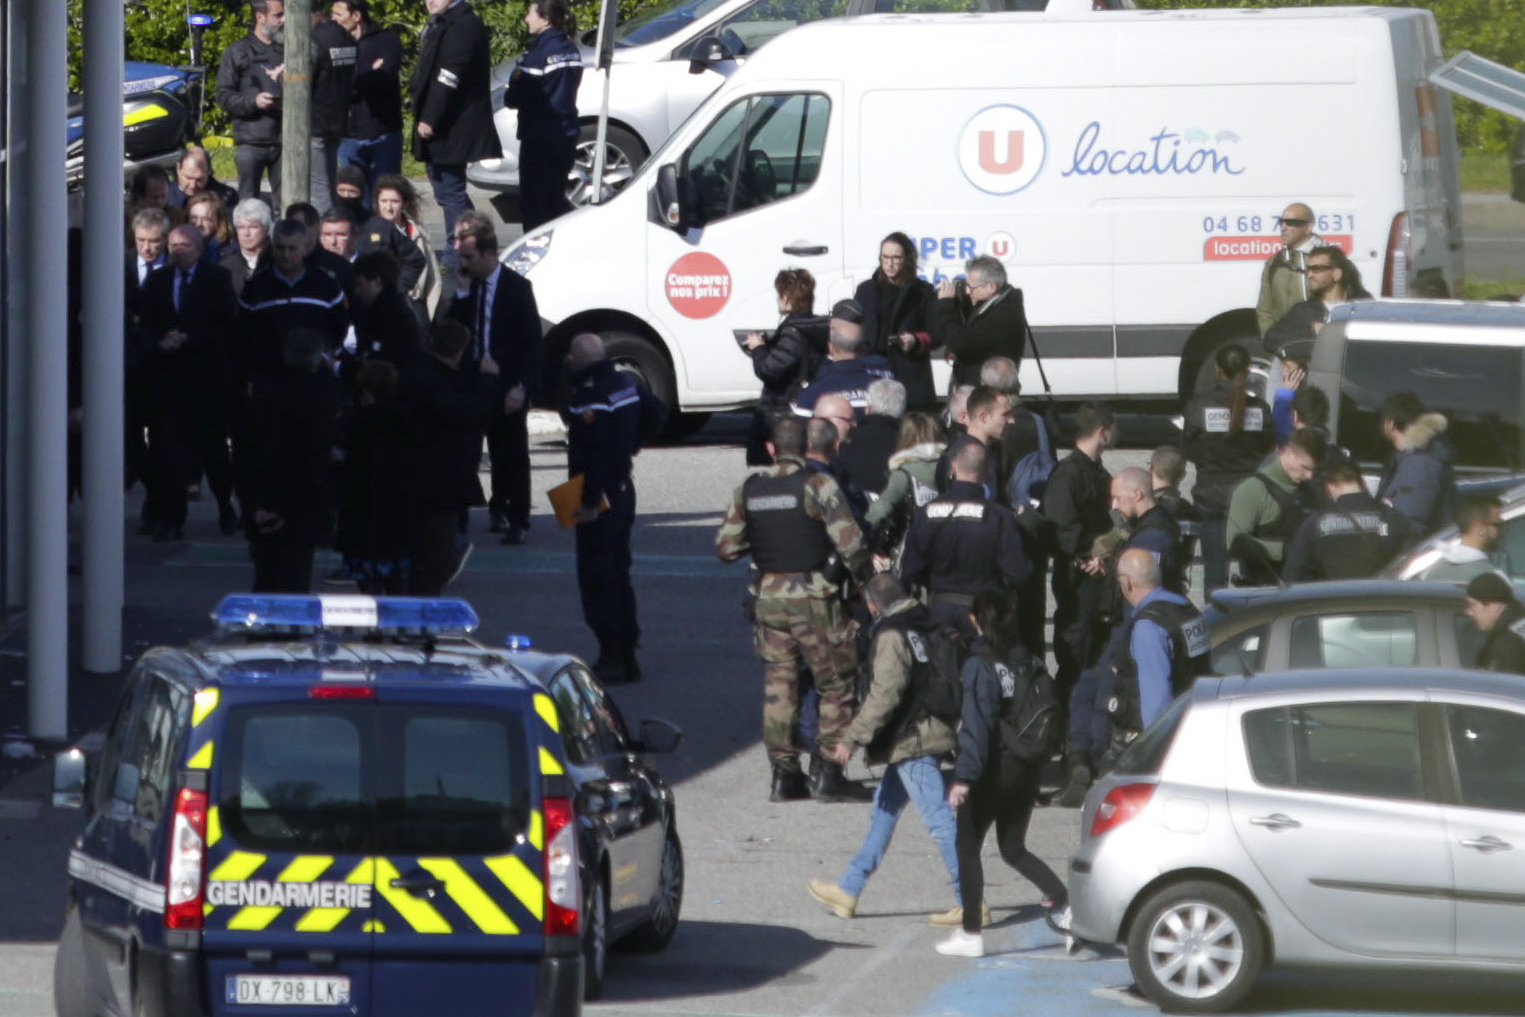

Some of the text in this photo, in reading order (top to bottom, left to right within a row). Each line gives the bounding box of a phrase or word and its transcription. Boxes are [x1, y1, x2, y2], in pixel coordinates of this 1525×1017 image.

[978, 121, 1246, 177] U location
[1203, 216, 1227, 232] 04
[1238, 216, 1262, 232] 68
[992, 241, 1008, 255] U
[668, 274, 728, 287] Comparez
[670, 288, 692, 297] nos
[695, 286, 721, 299] prix
[207, 880, 372, 909] GENDARMERIE
